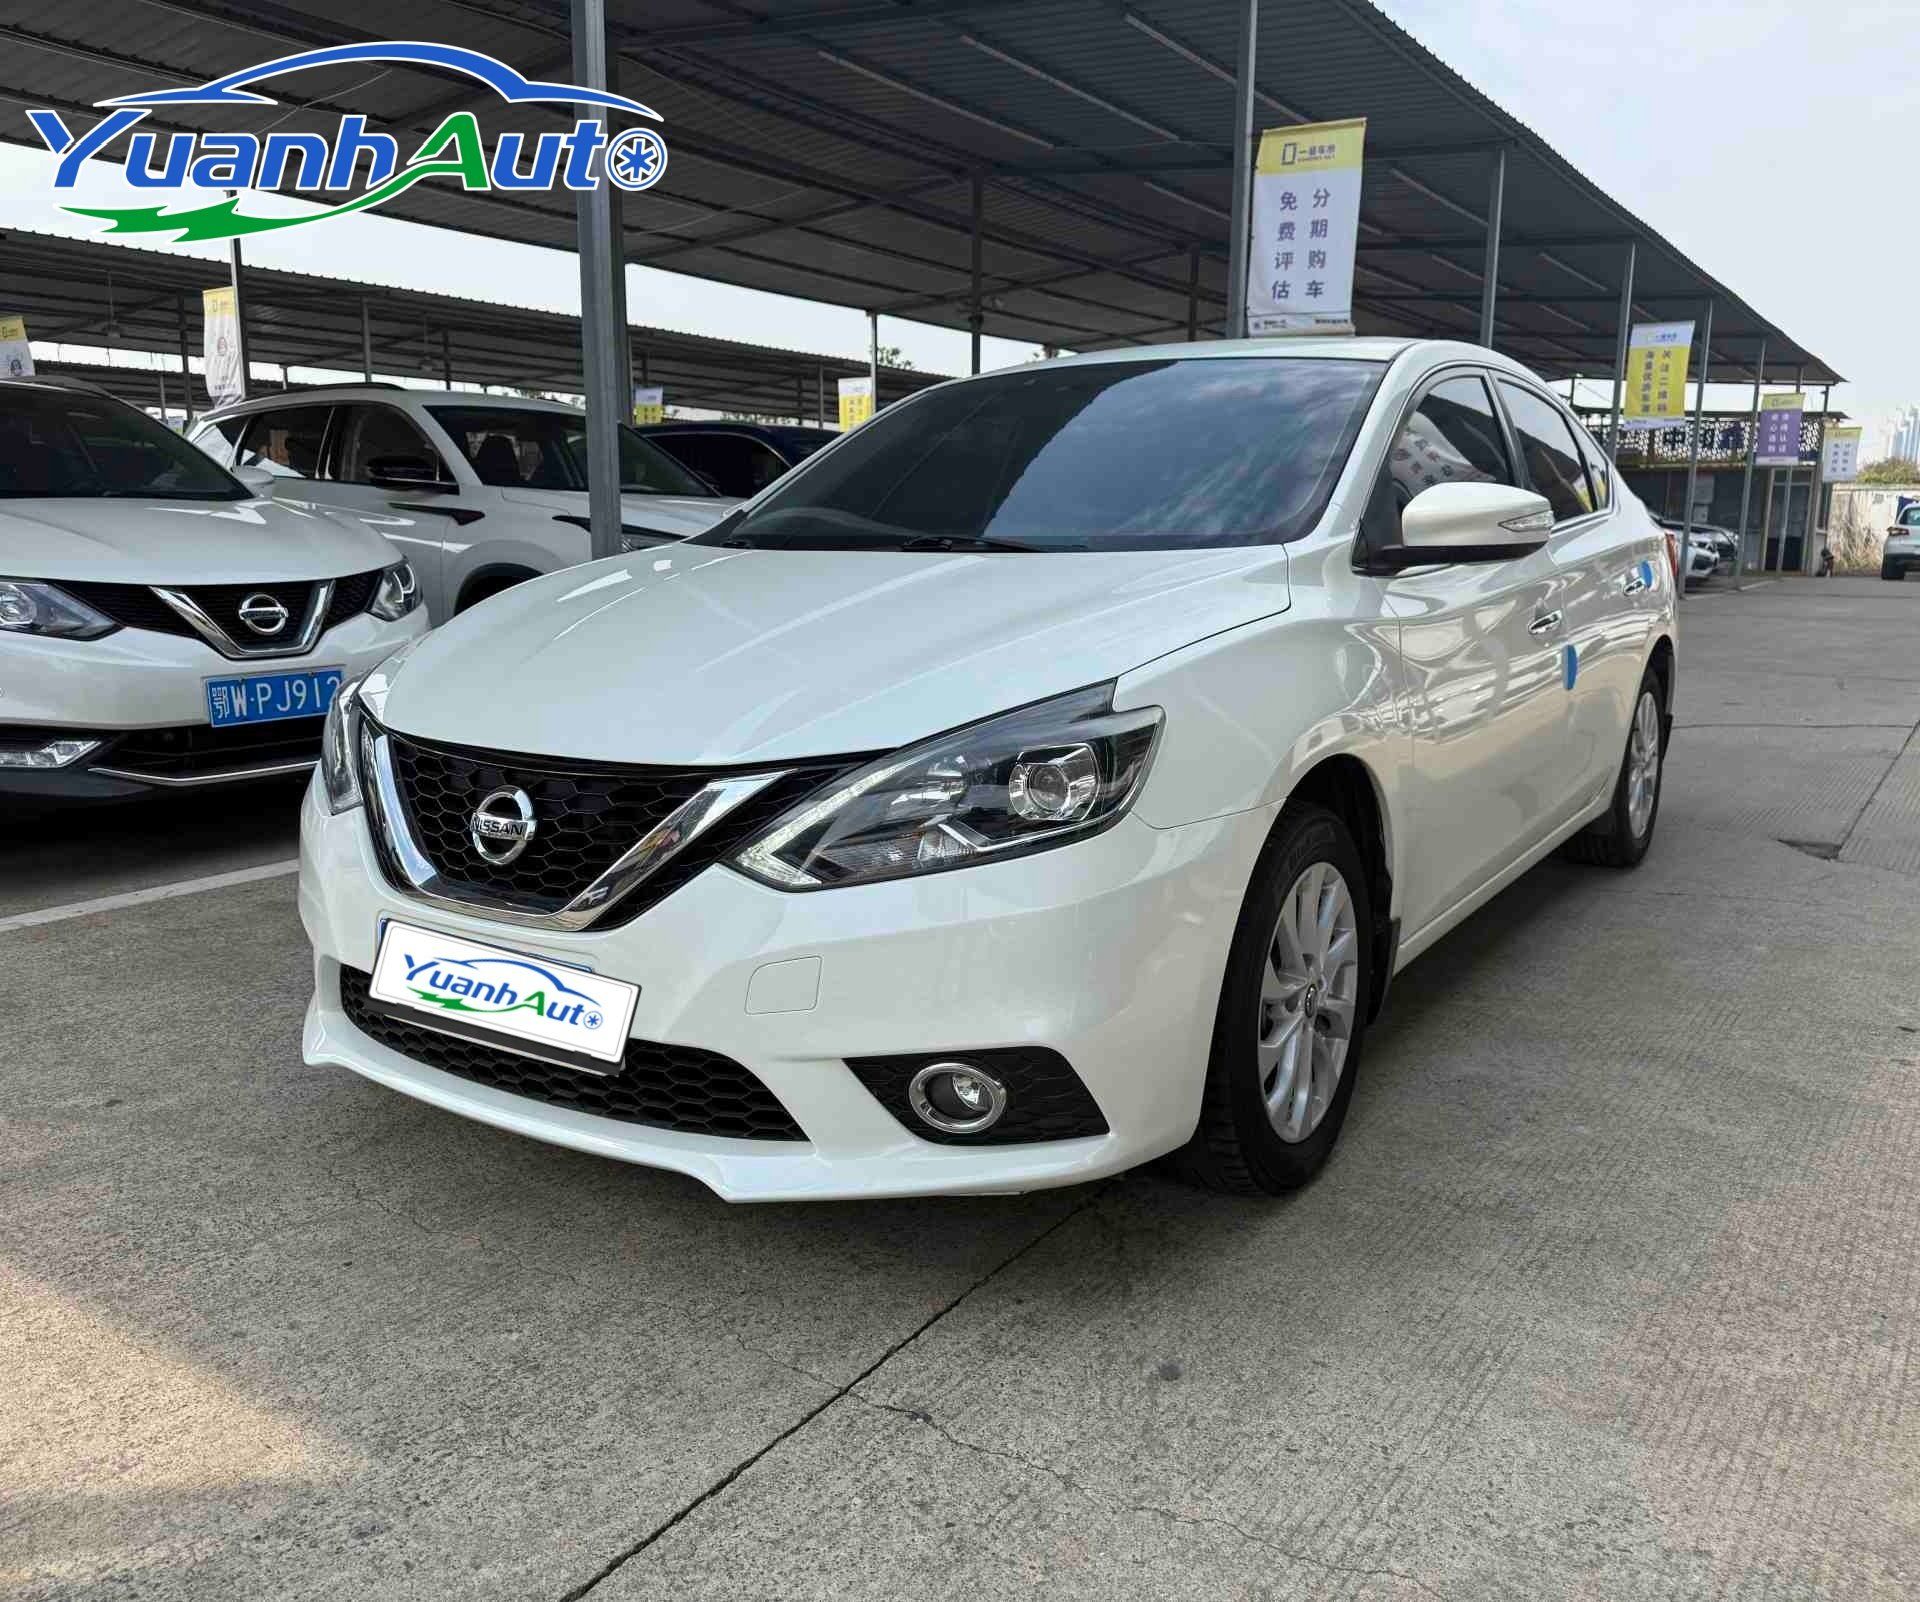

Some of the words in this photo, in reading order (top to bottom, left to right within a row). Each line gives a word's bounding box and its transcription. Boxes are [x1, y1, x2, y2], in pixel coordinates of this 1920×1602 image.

[1271, 191, 1299, 300] 免费评估
[1305, 187, 1331, 299] 分期购车
[470, 813, 525, 836] NISSAN
